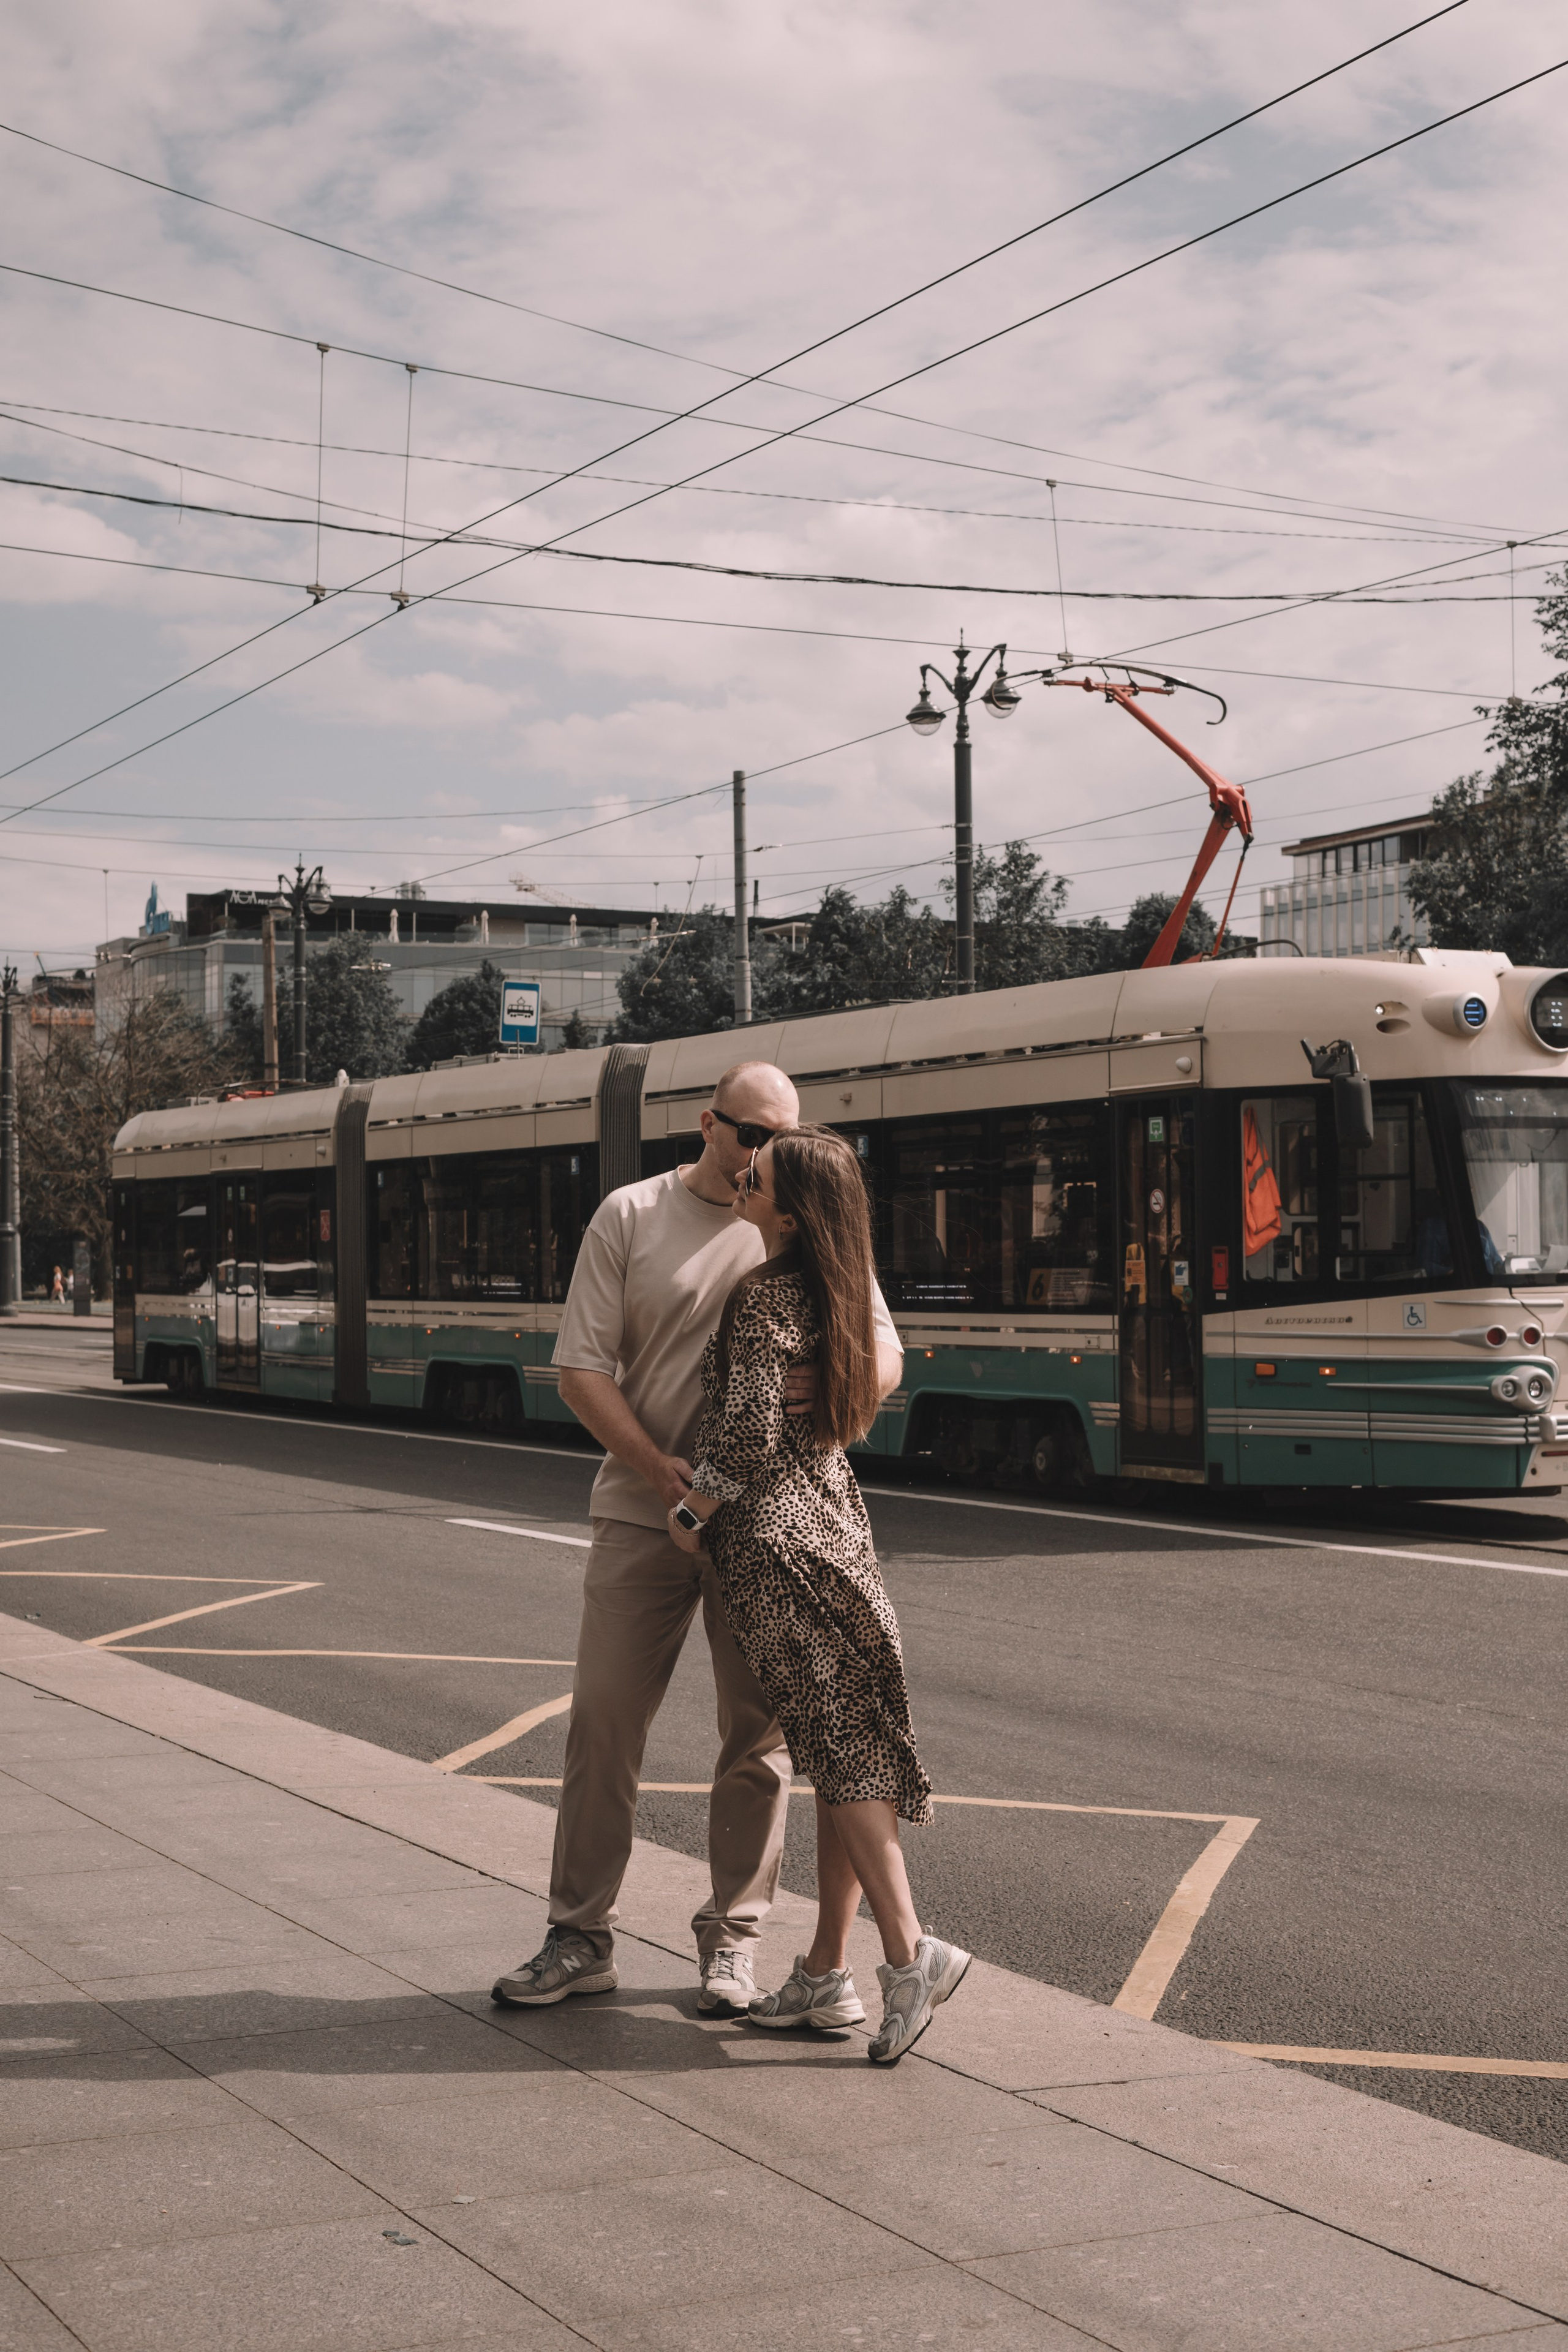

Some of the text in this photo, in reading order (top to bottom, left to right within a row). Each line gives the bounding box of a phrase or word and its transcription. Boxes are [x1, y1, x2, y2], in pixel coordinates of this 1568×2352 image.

[1031, 1273, 1045, 1301] 6
[561, 1955, 582, 1972] N
[785, 1984, 802, 2001] N
[894, 1988, 913, 2005] N
